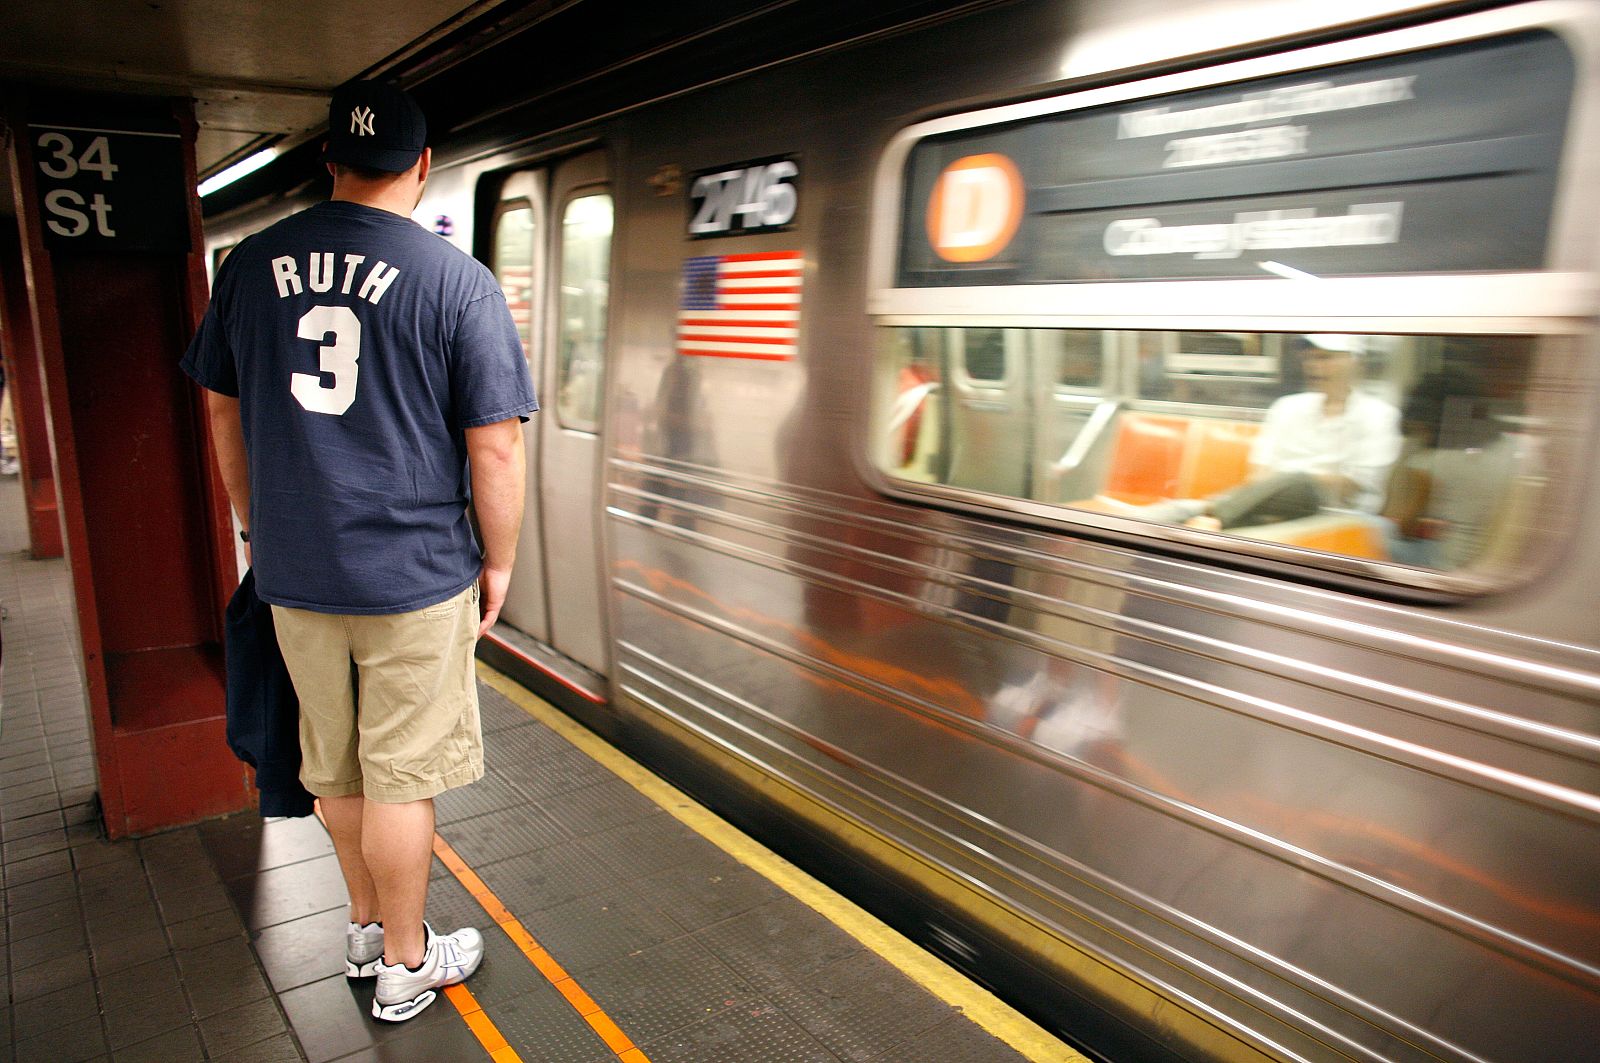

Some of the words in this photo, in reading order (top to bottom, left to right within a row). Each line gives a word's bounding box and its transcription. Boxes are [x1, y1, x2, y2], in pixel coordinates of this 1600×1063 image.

[350, 105, 375, 137] NY
[37, 132, 119, 181] 34
[44, 190, 117, 238] St
[937, 166, 1012, 248] D
[271, 252, 400, 305] RUTH
[290, 305, 362, 416] 3
